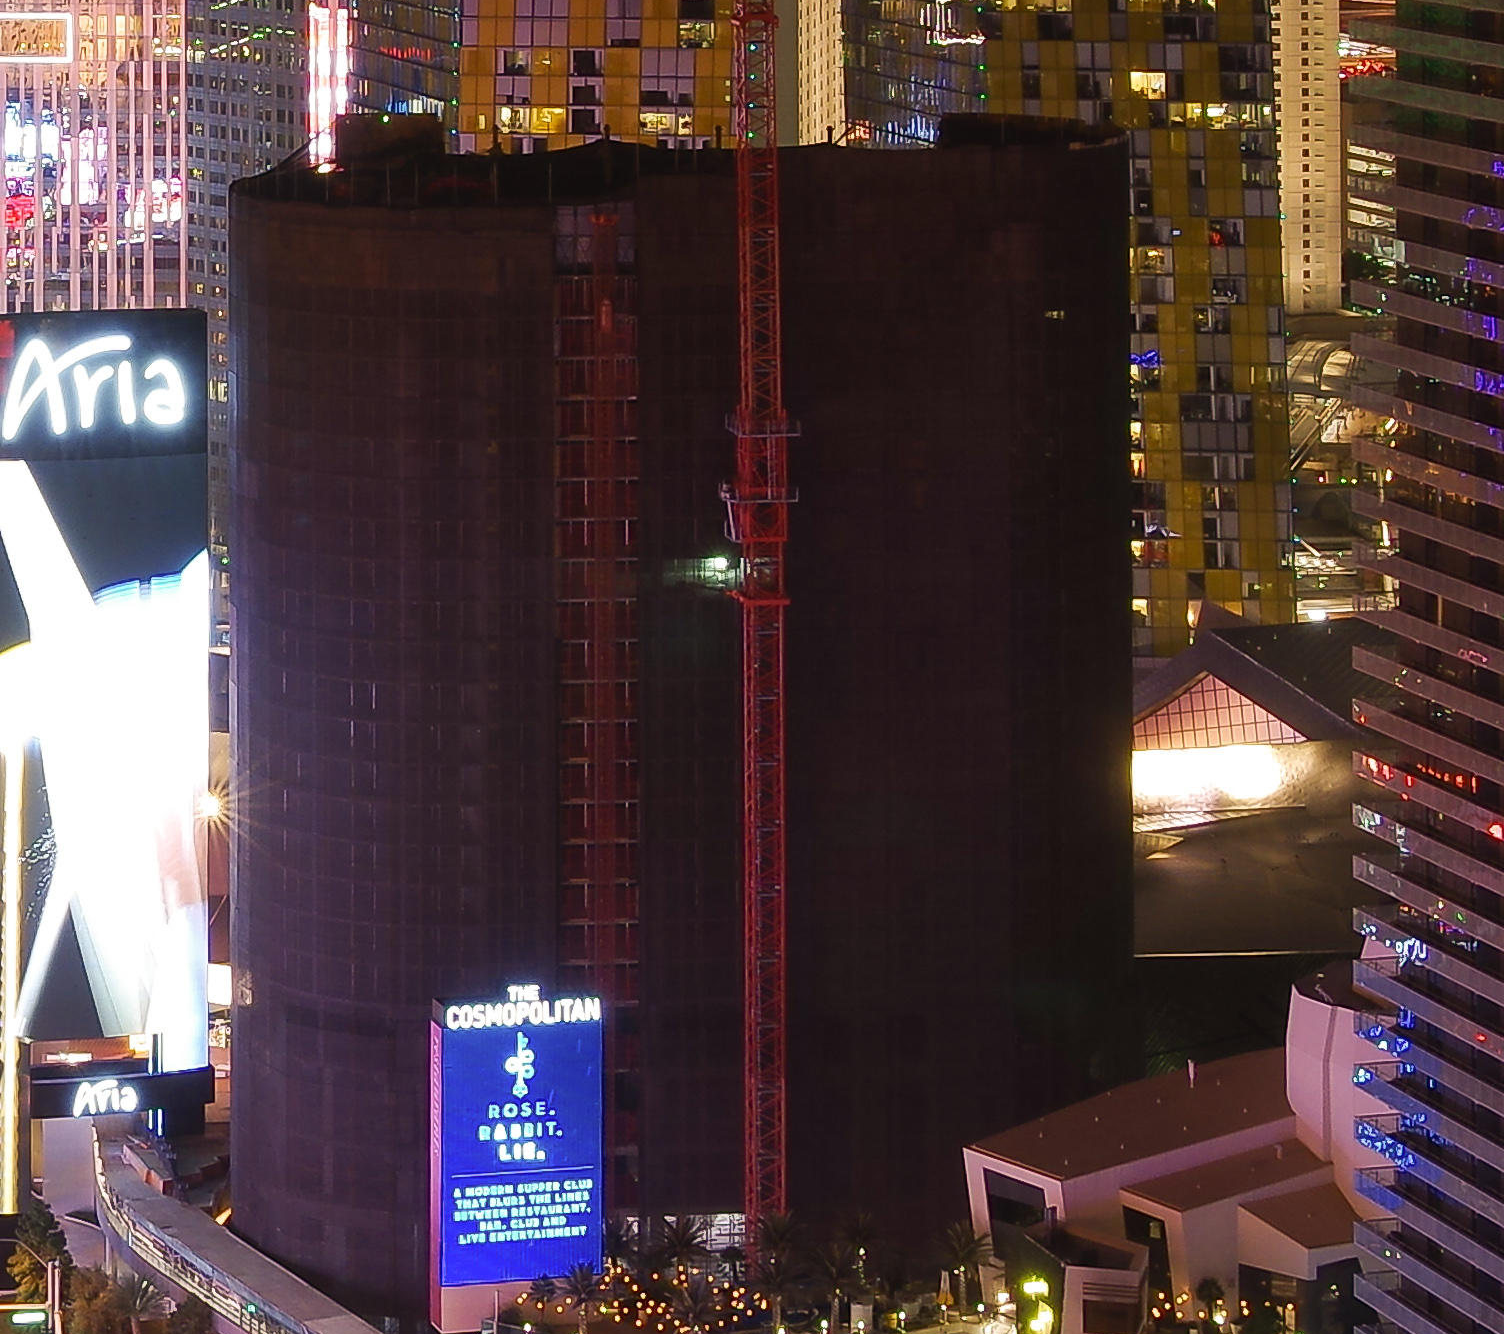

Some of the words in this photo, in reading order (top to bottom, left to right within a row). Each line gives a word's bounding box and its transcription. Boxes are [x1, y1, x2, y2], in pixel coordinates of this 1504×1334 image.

[507, 985, 540, 1002] THE
[446, 998, 601, 1030] COSMOPOLITAN
[488, 1102, 556, 1118] ROSE.
[478, 1121, 563, 1141] RABBIT.
[453, 1188, 462, 1198] A
[465, 1185, 514, 1197] MODERN
[517, 1182, 560, 1193] SUPPER
[564, 1179, 593, 1190] CLUB
[455, 1198, 487, 1209] THAT
[529, 1193, 551, 1204] THE
[555, 1191, 590, 1202] LINES
[454, 1209, 508, 1221] BETWEEN
[510, 1218, 540, 1228] CLUB
[542, 1216, 567, 1227] AND
[458, 1233, 486, 1244] LIVE
[489, 1226, 587, 1242] ENTERTAINMENT
